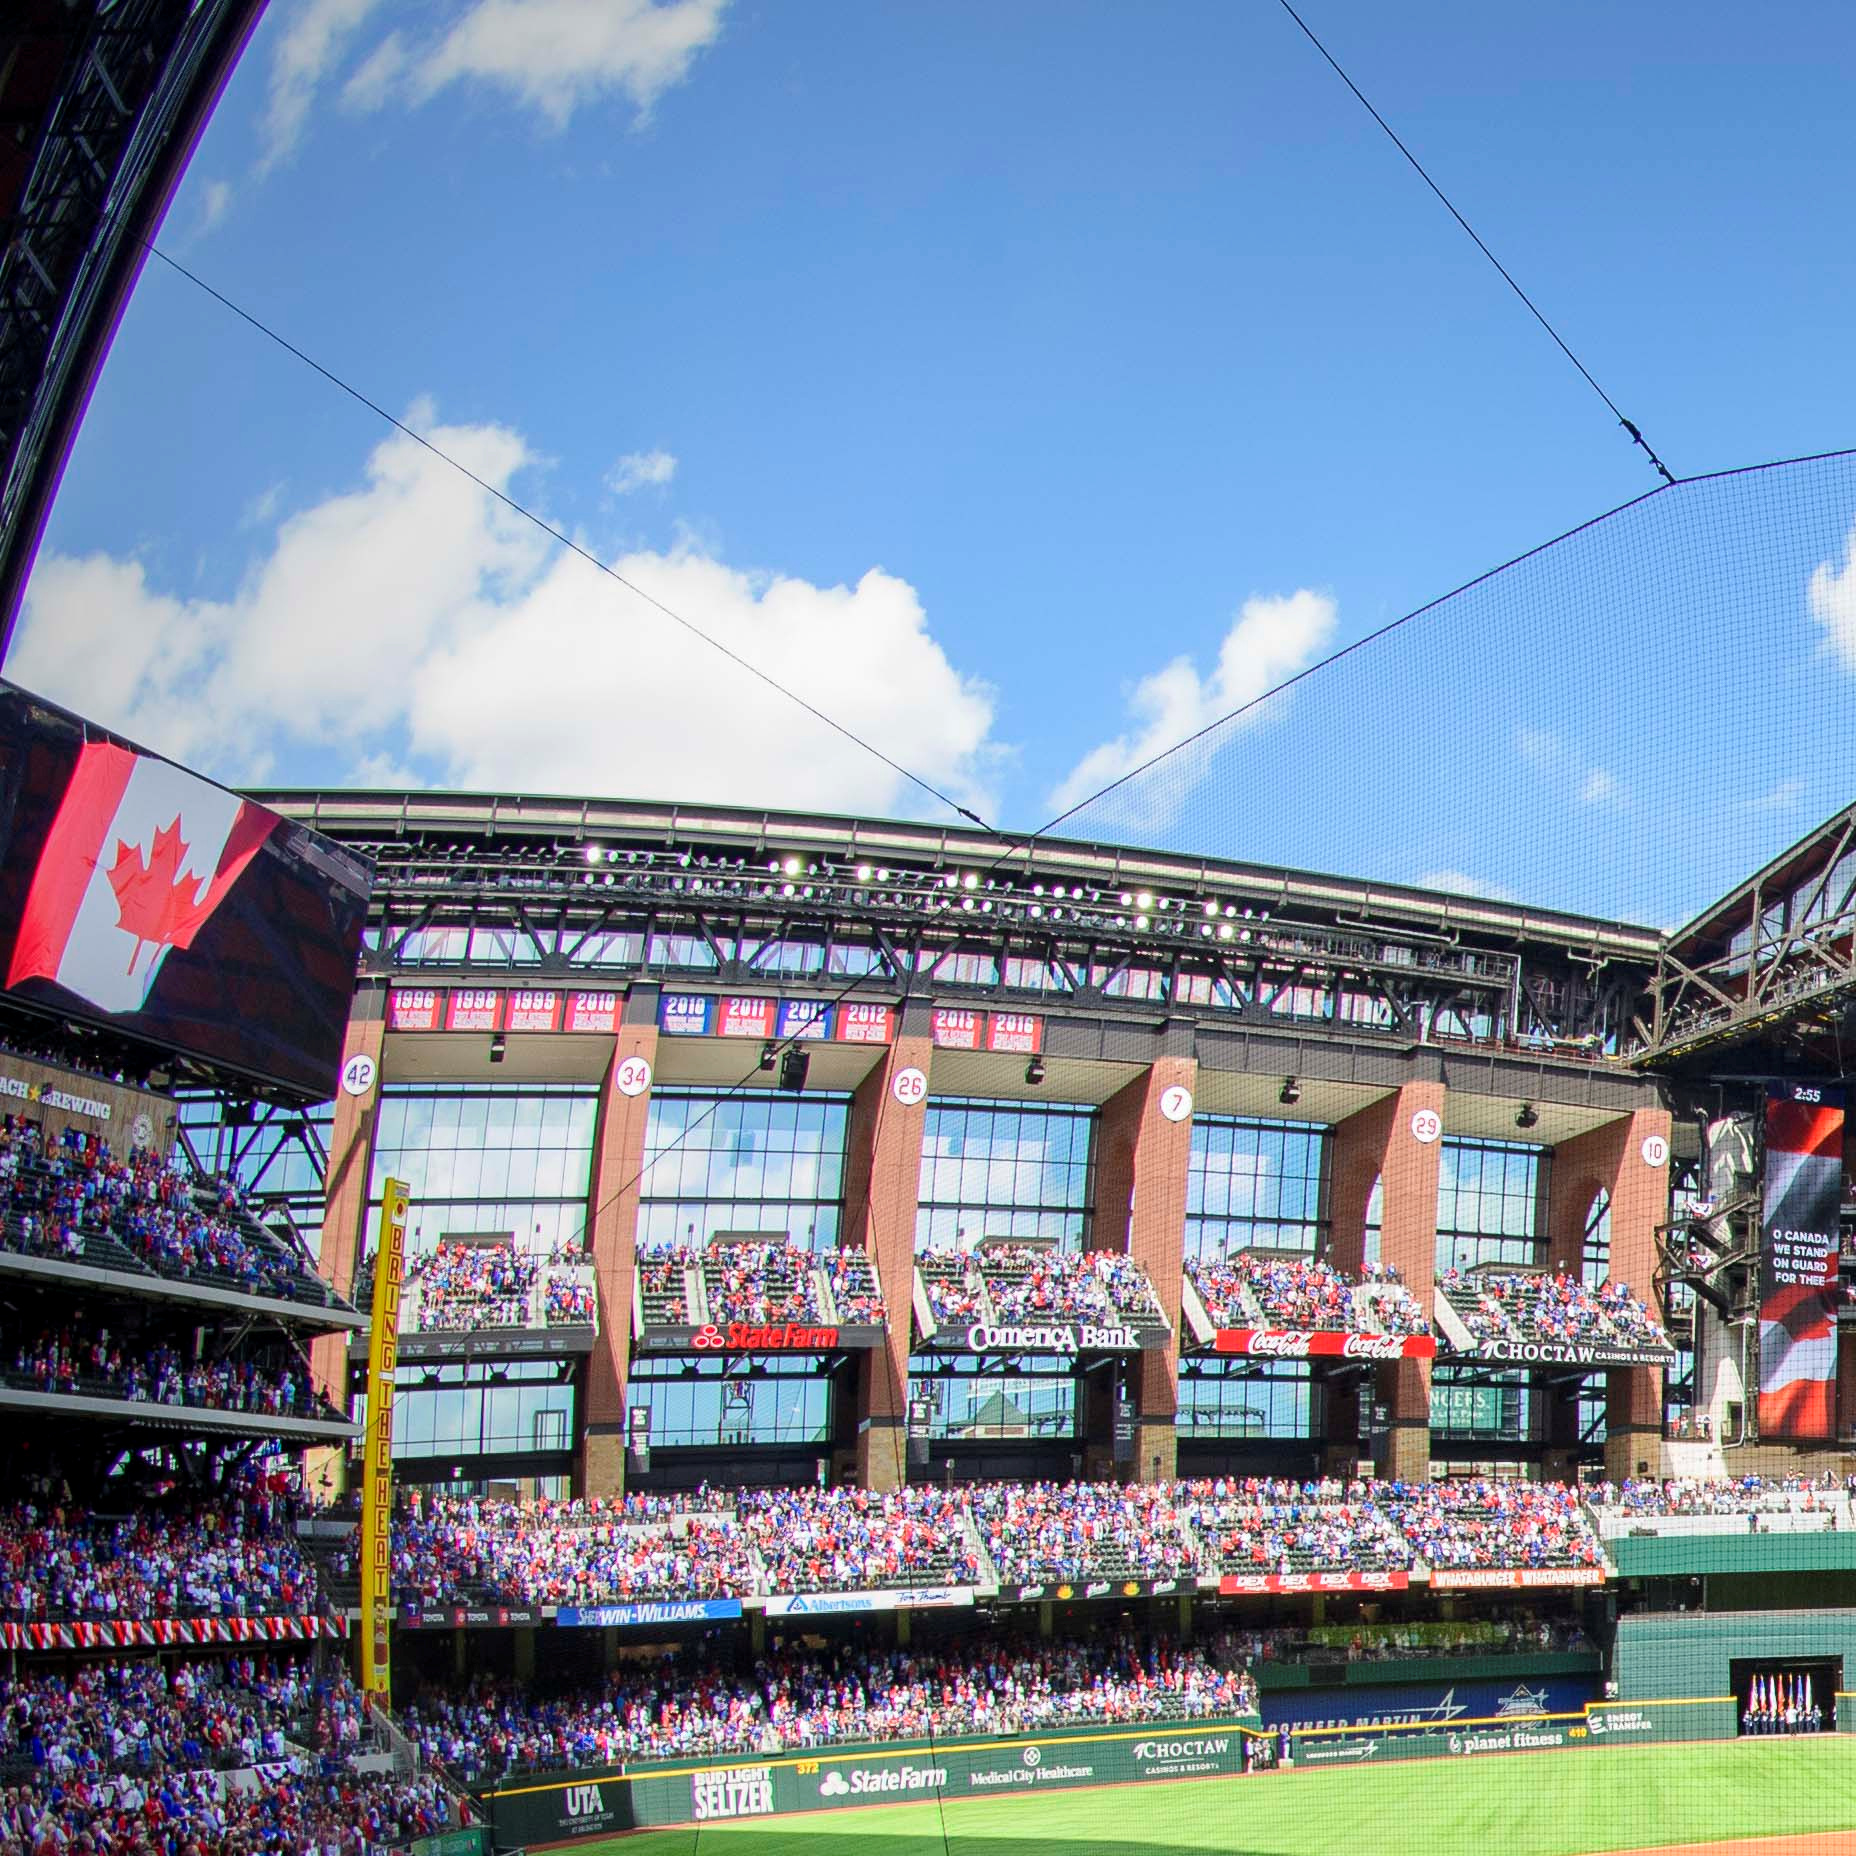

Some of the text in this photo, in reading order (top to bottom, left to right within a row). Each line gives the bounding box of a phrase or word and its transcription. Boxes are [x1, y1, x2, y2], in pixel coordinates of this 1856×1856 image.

[395, 991, 435, 1009] 1996
[514, 991, 555, 1010] 1999
[575, 993, 616, 1011] 2010
[666, 997, 705, 1014] 2010
[728, 998, 766, 1017] 2011
[846, 1004, 887, 1023] 2012
[936, 1010, 974, 1029] 2015
[347, 1064, 370, 1085] 42
[622, 1067, 646, 1086] 34
[899, 1076, 922, 1095] 26
[1794, 1087, 1821, 1103] 2:55
[1172, 1094, 1183, 1112] 7
[1416, 1117, 1436, 1135] 29
[1649, 1141, 1662, 1160] 10
[1773, 1229, 1829, 1244] O CANADA
[1774, 1243, 1828, 1258] WE STAND
[1773, 1258, 1828, 1272] ON GUARD
[1775, 1272, 1826, 1286] FOR THEE
[381, 1227, 402, 1370] BRING
[1081, 1325, 1141, 1349] Bank
[1248, 1331, 1314, 1356] Coca-Cola
[1344, 1333, 1408, 1359] Coca-Cola
[1493, 1339, 1595, 1363] CHOCTAW
[377, 1381, 392, 1467] THE
[374, 1479, 389, 1596] HEAT
[1237, 1575, 1266, 1588] DEX
[1279, 1574, 1309, 1587] DEX
[1321, 1573, 1350, 1586] DEX
[1362, 1572, 1391, 1585] DEX
[1435, 1570, 1600, 1587] WHATABURGER WHATABURGER
[809, 1597, 873, 1612] Albertsons
[1606, 1712, 1643, 1722] ENERGY
[1606, 1720, 1653, 1730] TRANSFER
[1144, 1740, 1230, 1759] CHOCTAW
[1464, 1733, 1563, 1755] planet fitness
[694, 1768, 771, 1787] BUD LIGHT
[971, 1766, 1093, 1786] Medical City Healthcare
[565, 1784, 604, 1816] UTA
[695, 1780, 774, 1820] SELTZER
